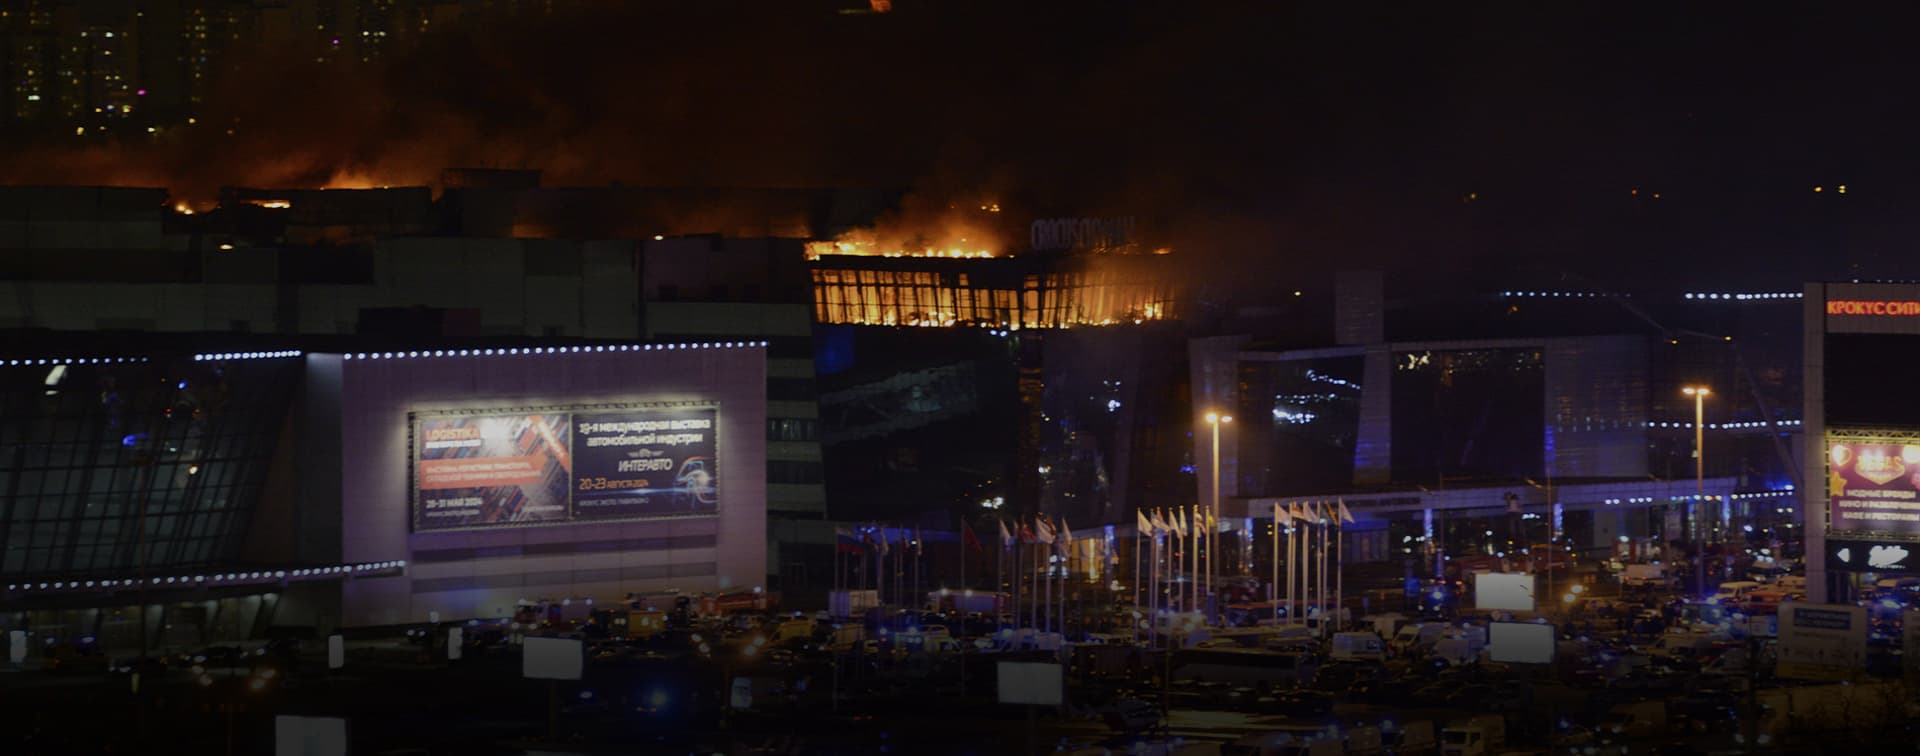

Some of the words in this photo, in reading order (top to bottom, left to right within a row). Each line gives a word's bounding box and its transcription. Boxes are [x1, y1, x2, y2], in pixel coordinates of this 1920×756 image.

[1827, 301, 1885, 315] КРОКУС
[600, 420, 670, 434] международная
[425, 428, 480, 440] LOGISTIKA
[587, 434, 656, 447] автомобильной
[618, 458, 673, 472] ИНТЕРАВТО
[579, 478, 606, 490] 20-23
